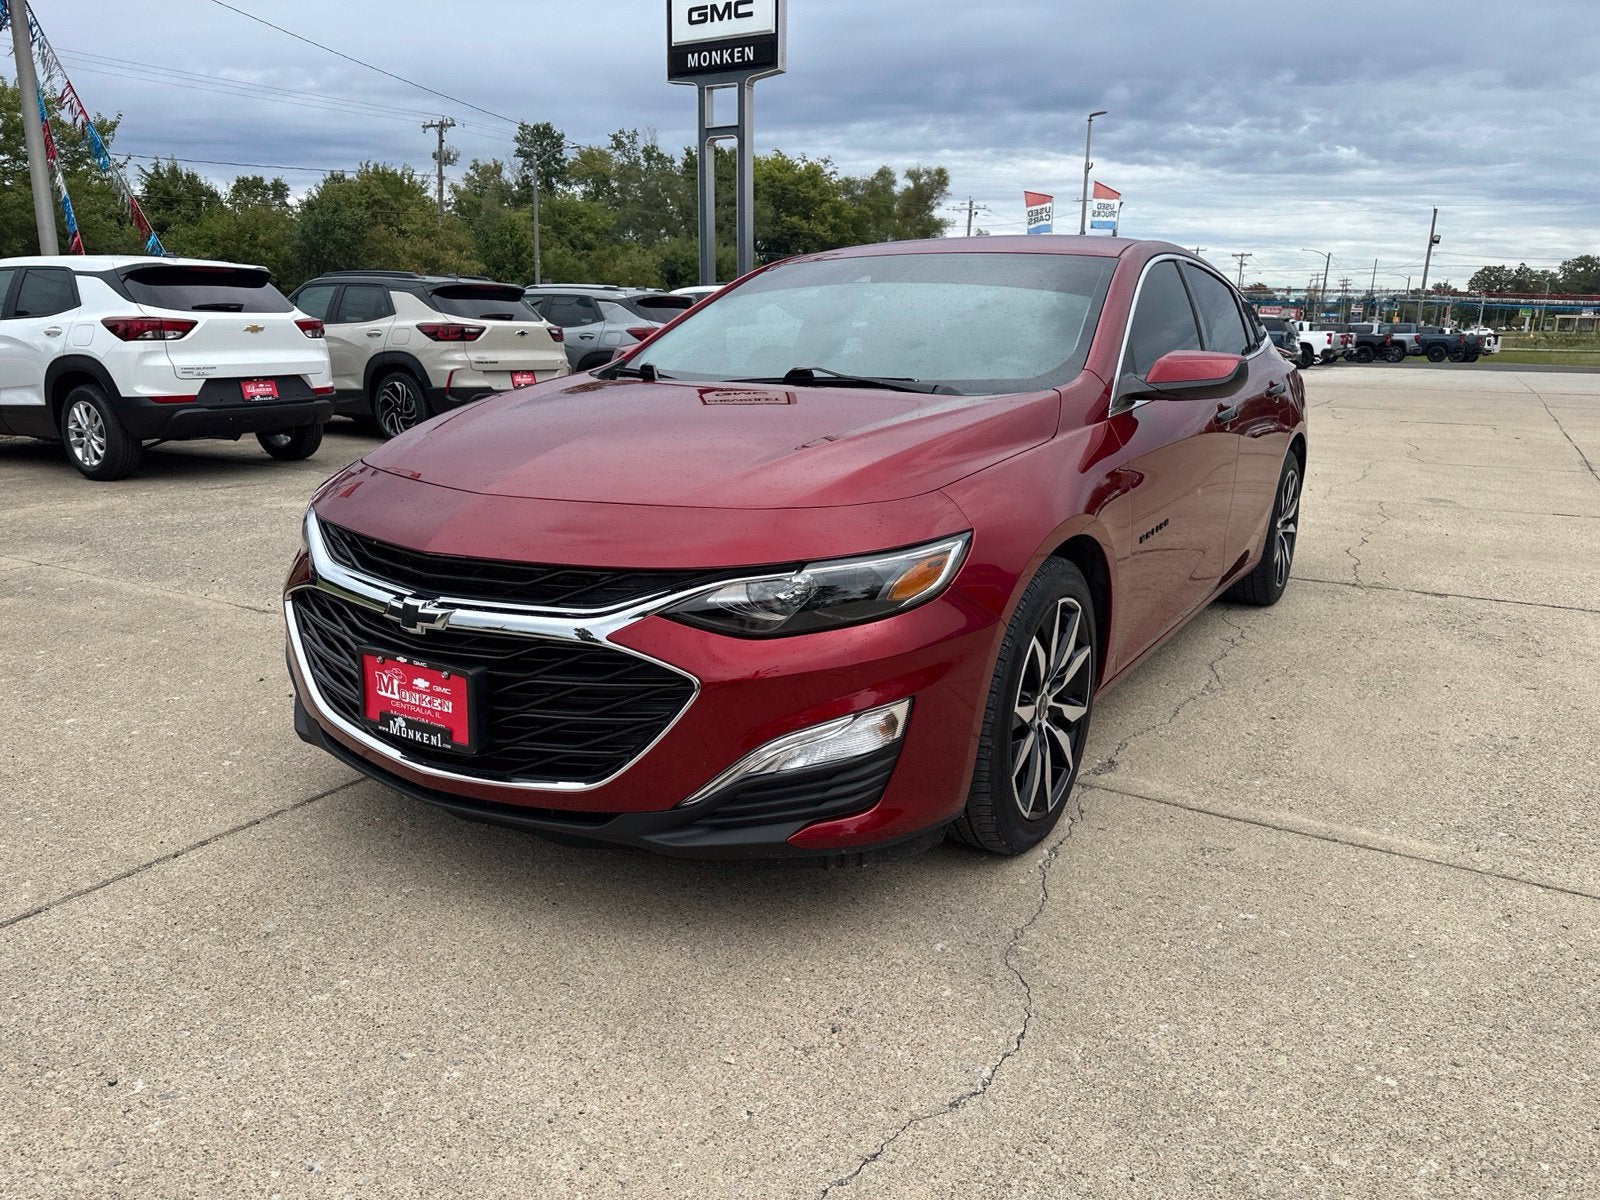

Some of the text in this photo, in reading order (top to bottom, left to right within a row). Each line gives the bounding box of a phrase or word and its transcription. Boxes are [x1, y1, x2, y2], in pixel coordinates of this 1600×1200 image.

[688, 1, 754, 26] GMC
[687, 46, 754, 68] MONKEN
[412, 660, 427, 668] GMC
[375, 671, 453, 713] MONKEN
[432, 685, 452, 695] GMC
[390, 700, 443, 719] CENTRALIA, IL
